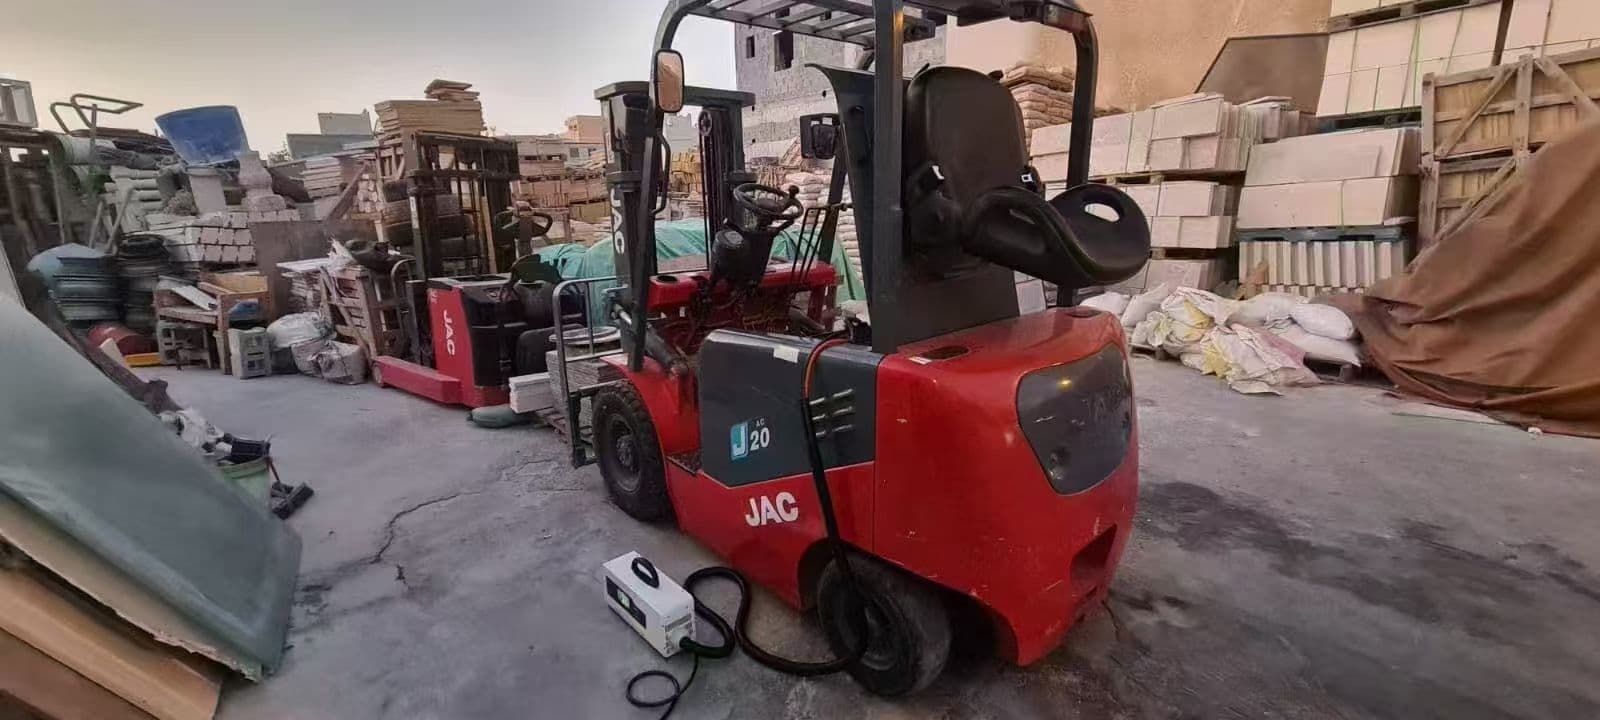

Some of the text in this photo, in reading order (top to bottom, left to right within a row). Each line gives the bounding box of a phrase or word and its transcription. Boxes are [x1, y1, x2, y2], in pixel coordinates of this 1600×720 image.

[610, 188, 625, 254] JAC
[444, 309, 455, 356] JAC
[750, 427, 770, 451] 20
[745, 491, 799, 527] JAC
